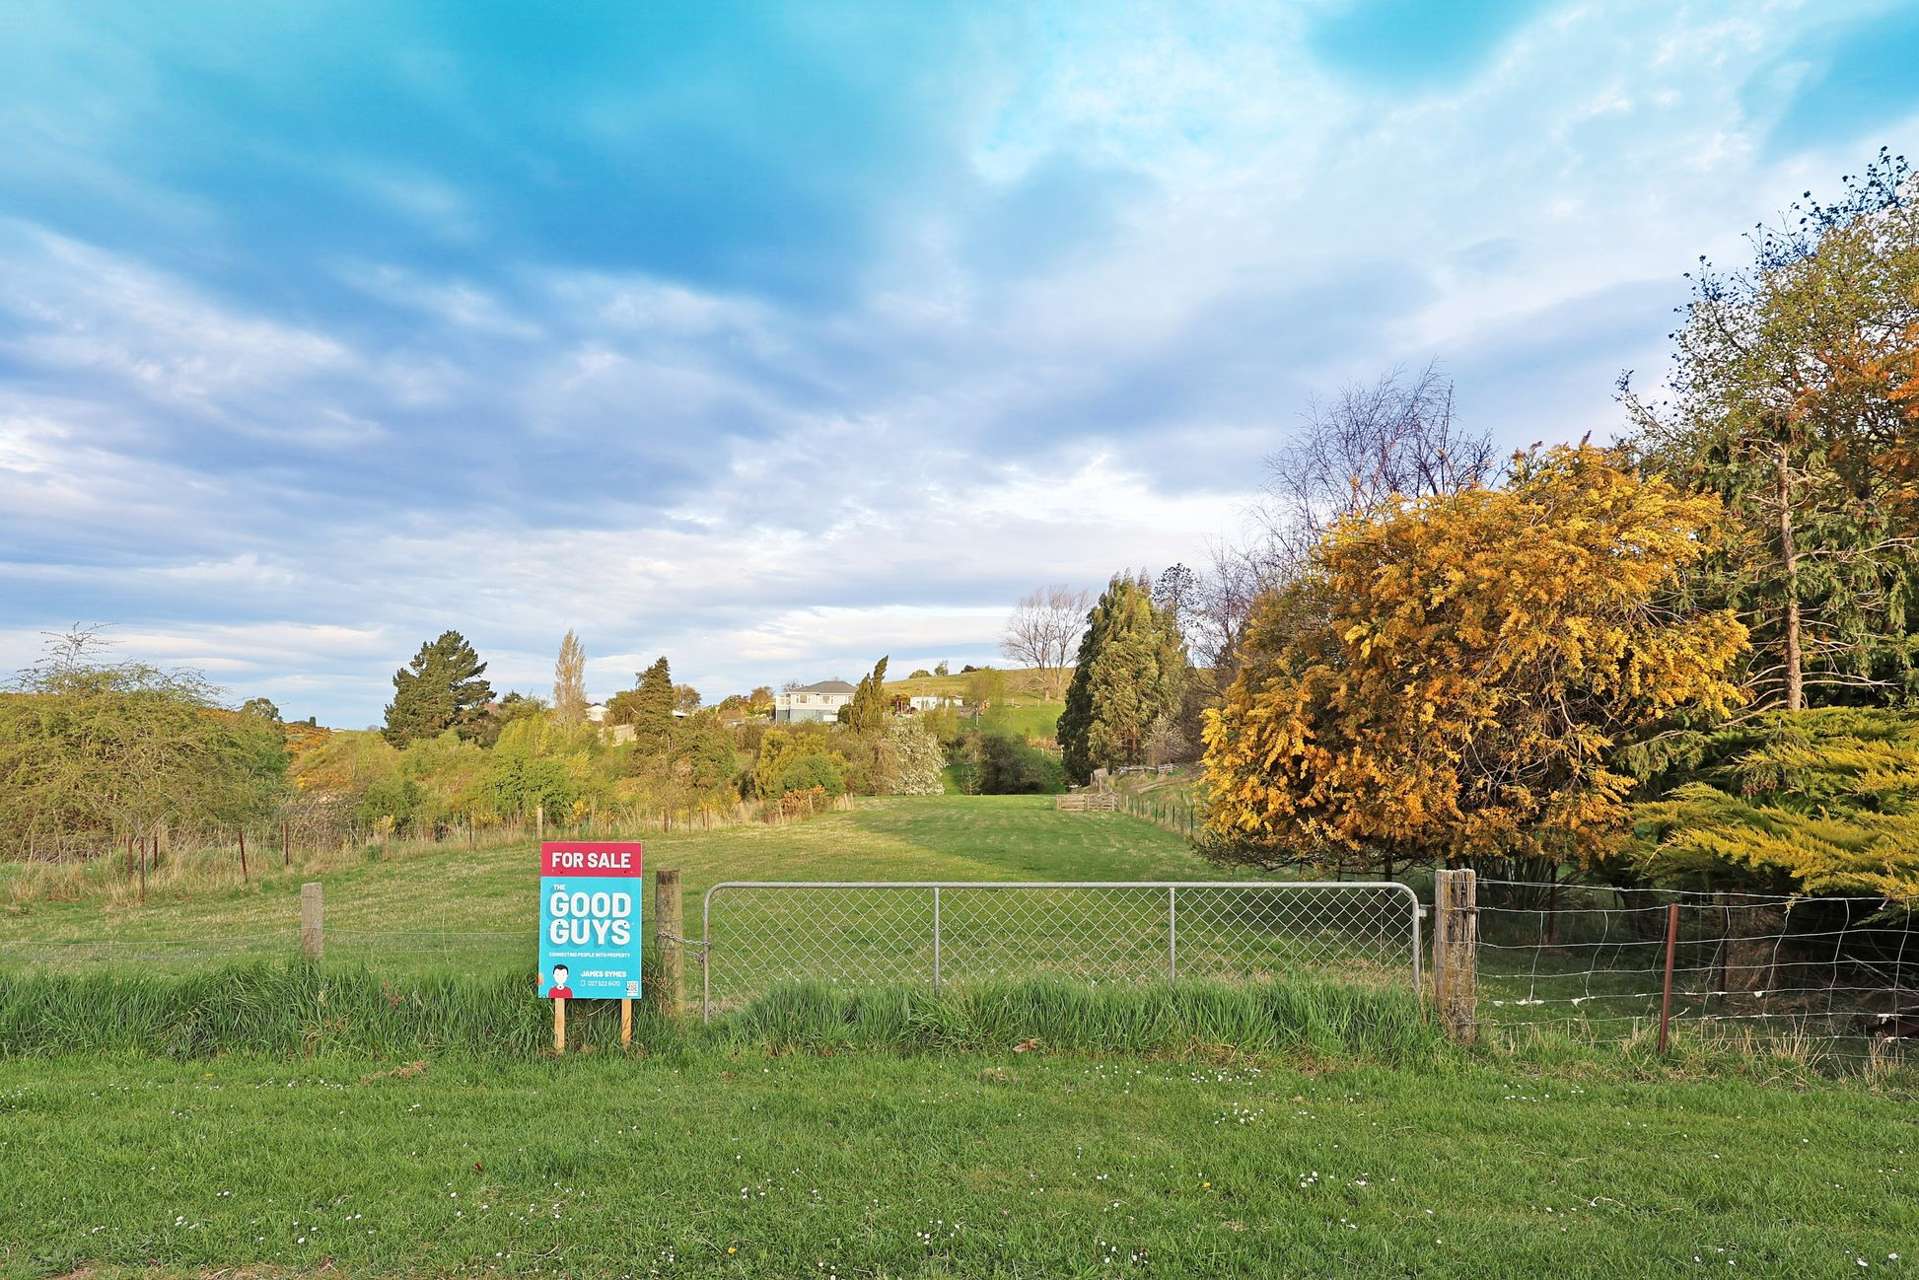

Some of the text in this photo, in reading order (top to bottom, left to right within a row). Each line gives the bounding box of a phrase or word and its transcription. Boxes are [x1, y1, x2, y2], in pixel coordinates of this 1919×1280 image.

[552, 852, 632, 868] FOR SALE
[550, 892, 631, 918] GOOD
[549, 918, 631, 945] GUYS
[581, 970, 604, 978] JAMES
